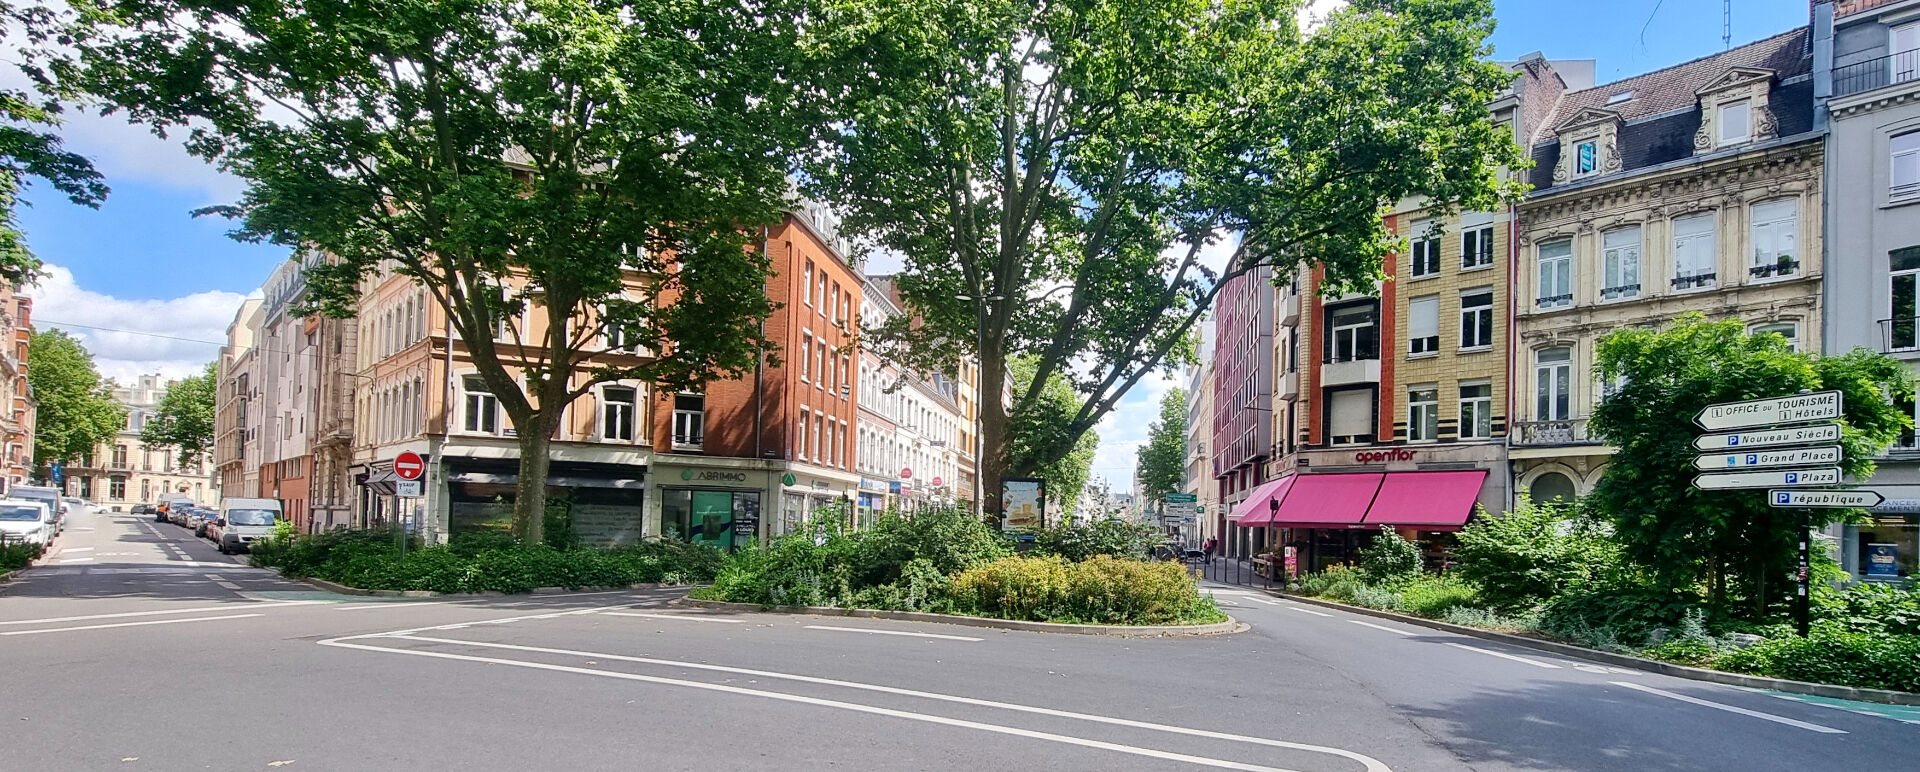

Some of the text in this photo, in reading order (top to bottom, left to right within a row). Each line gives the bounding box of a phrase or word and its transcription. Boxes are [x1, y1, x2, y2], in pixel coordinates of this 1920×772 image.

[1726, 405, 1759, 415] OFFICE
[1777, 395, 1834, 409] TOURISME
[1795, 408, 1834, 418] Hôtels
[1742, 433, 1789, 443] Nouveau
[1796, 429, 1833, 439] Siècle
[1356, 448, 1417, 464] openflor
[1761, 453, 1794, 462] Grand
[1801, 451, 1833, 460] Place
[698, 472, 746, 481] ABRIMMO
[1801, 473, 1833, 481] Plaza
[1794, 494, 1863, 504] république
